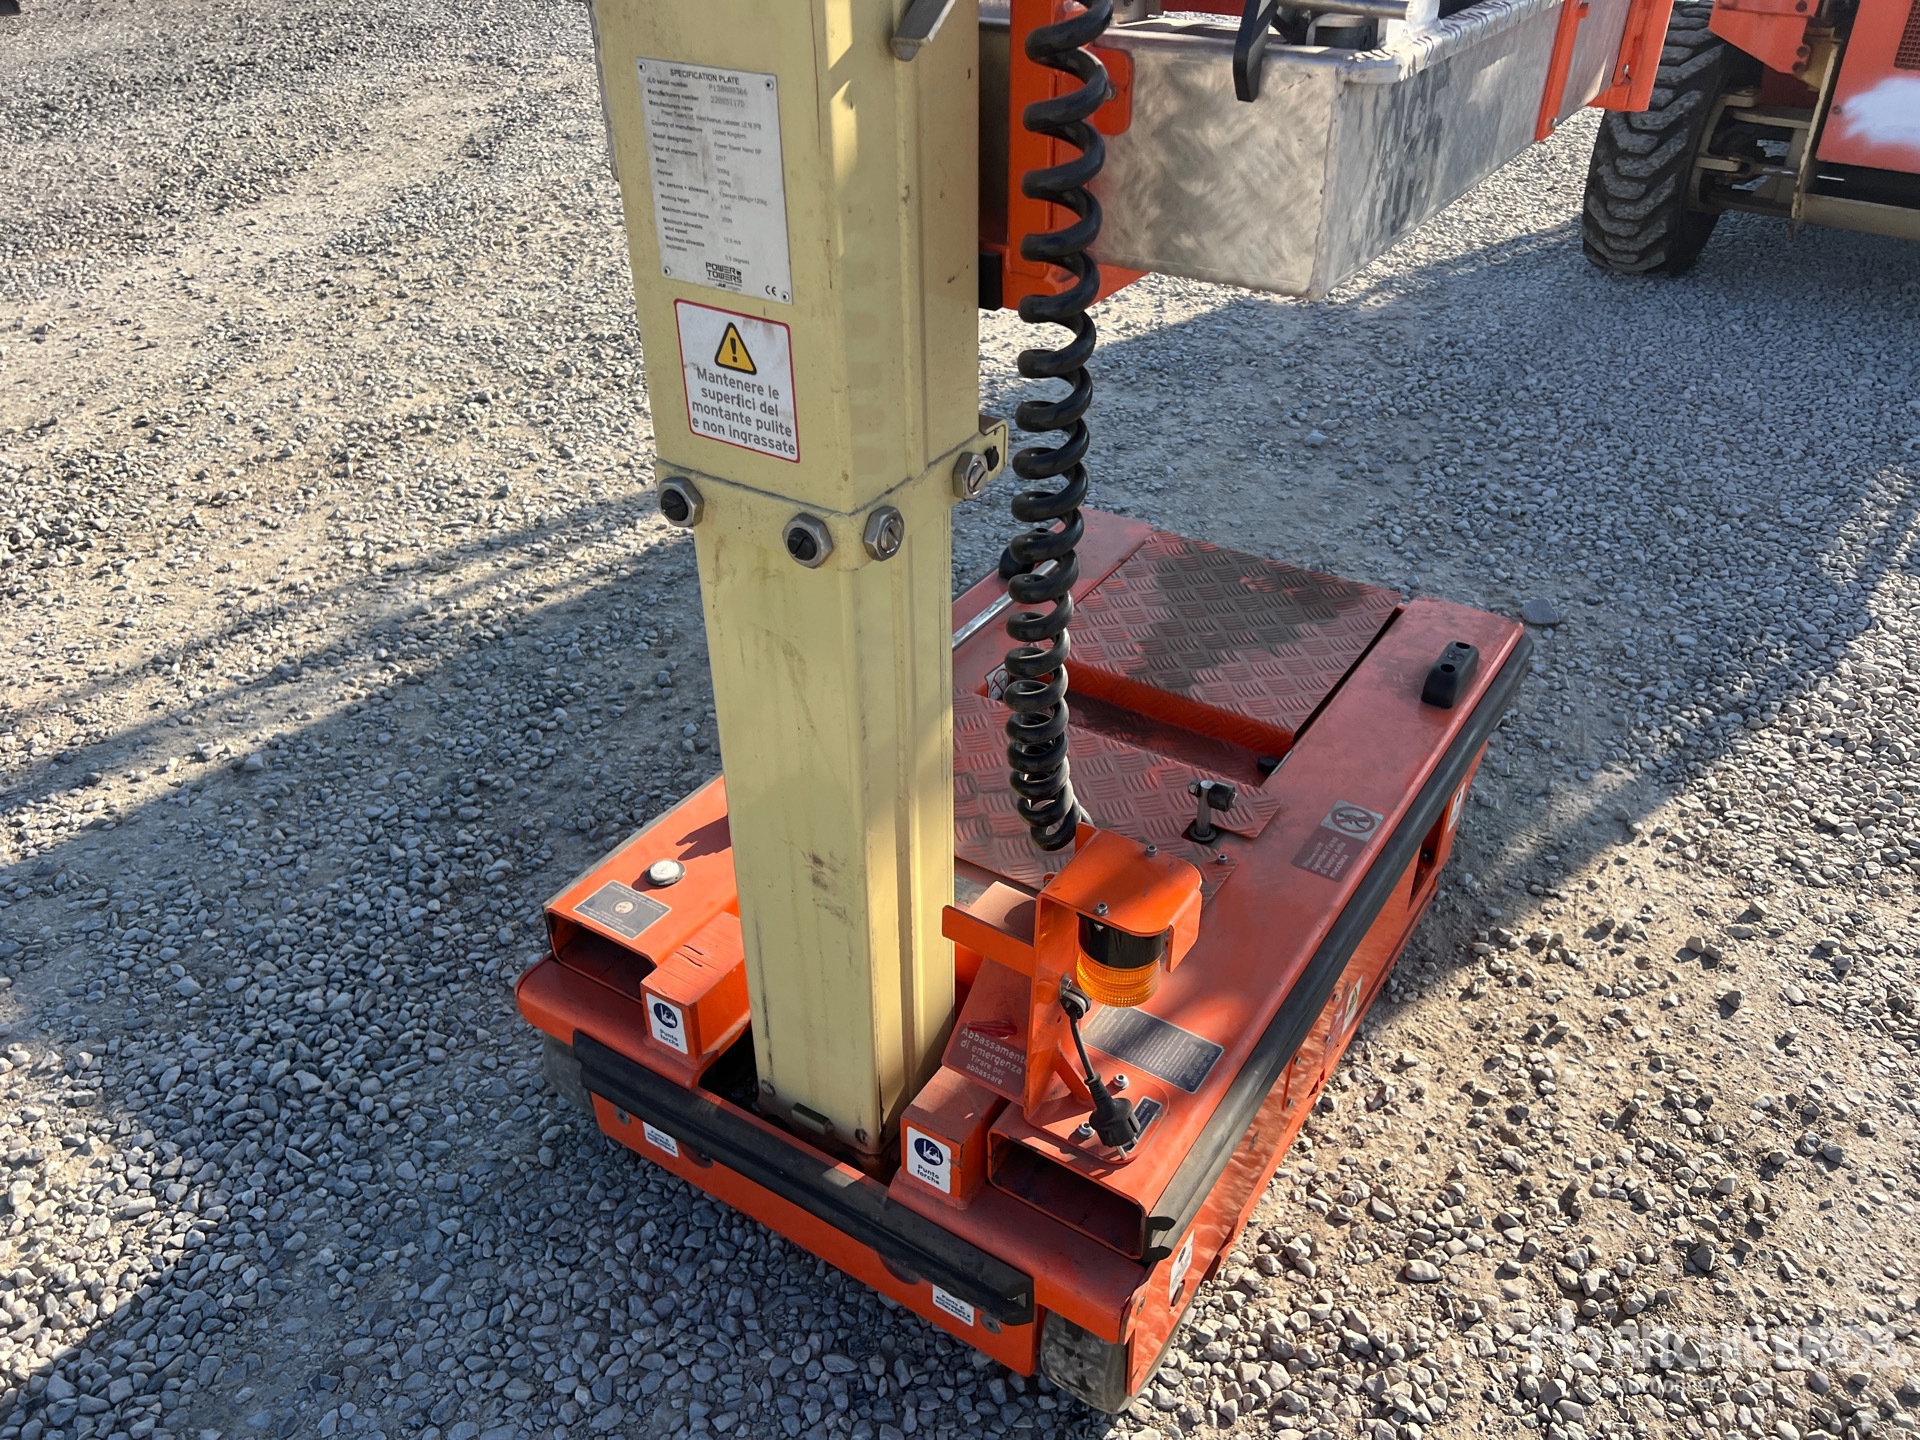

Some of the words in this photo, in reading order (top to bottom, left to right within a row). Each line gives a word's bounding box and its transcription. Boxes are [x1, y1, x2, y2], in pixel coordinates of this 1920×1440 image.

[670, 69, 718, 82] SPECIFICATION
[719, 75, 740, 84] PLATE
[651, 120, 669, 128] Country
[675, 124, 703, 132] manufacture
[667, 135, 692, 144] designation
[727, 131, 747, 140] Kingdom
[657, 169, 673, 177] Payload
[660, 194, 677, 202] Working
[662, 205, 681, 214] Maximum
[663, 217, 683, 225] Maximum
[665, 235, 685, 243] Maximum
[686, 239, 705, 247] allowable
[706, 262, 736, 274] POWER
[707, 270, 742, 283] TOWERS
[696, 366, 764, 396] Mantenere
[768, 386, 780, 400] le
[701, 387, 756, 411] superfici
[760, 401, 778, 417] del
[692, 401, 752, 426] montante
[756, 418, 792, 437] pulite
[692, 417, 699, 427] e
[703, 420, 725, 435] non
[728, 425, 796, 454] ingrassate
[660, 1029, 678, 1041] Punto
[960, 1040, 970, 1048] di
[972, 1045, 1022, 1074] emergenza
[971, 1054, 992, 1070] Tirare
[993, 1066, 1006, 1076] per
[966, 1064, 1002, 1084] abbassare
[917, 1170, 940, 1184] forche
[918, 1164, 939, 1179] Punto
